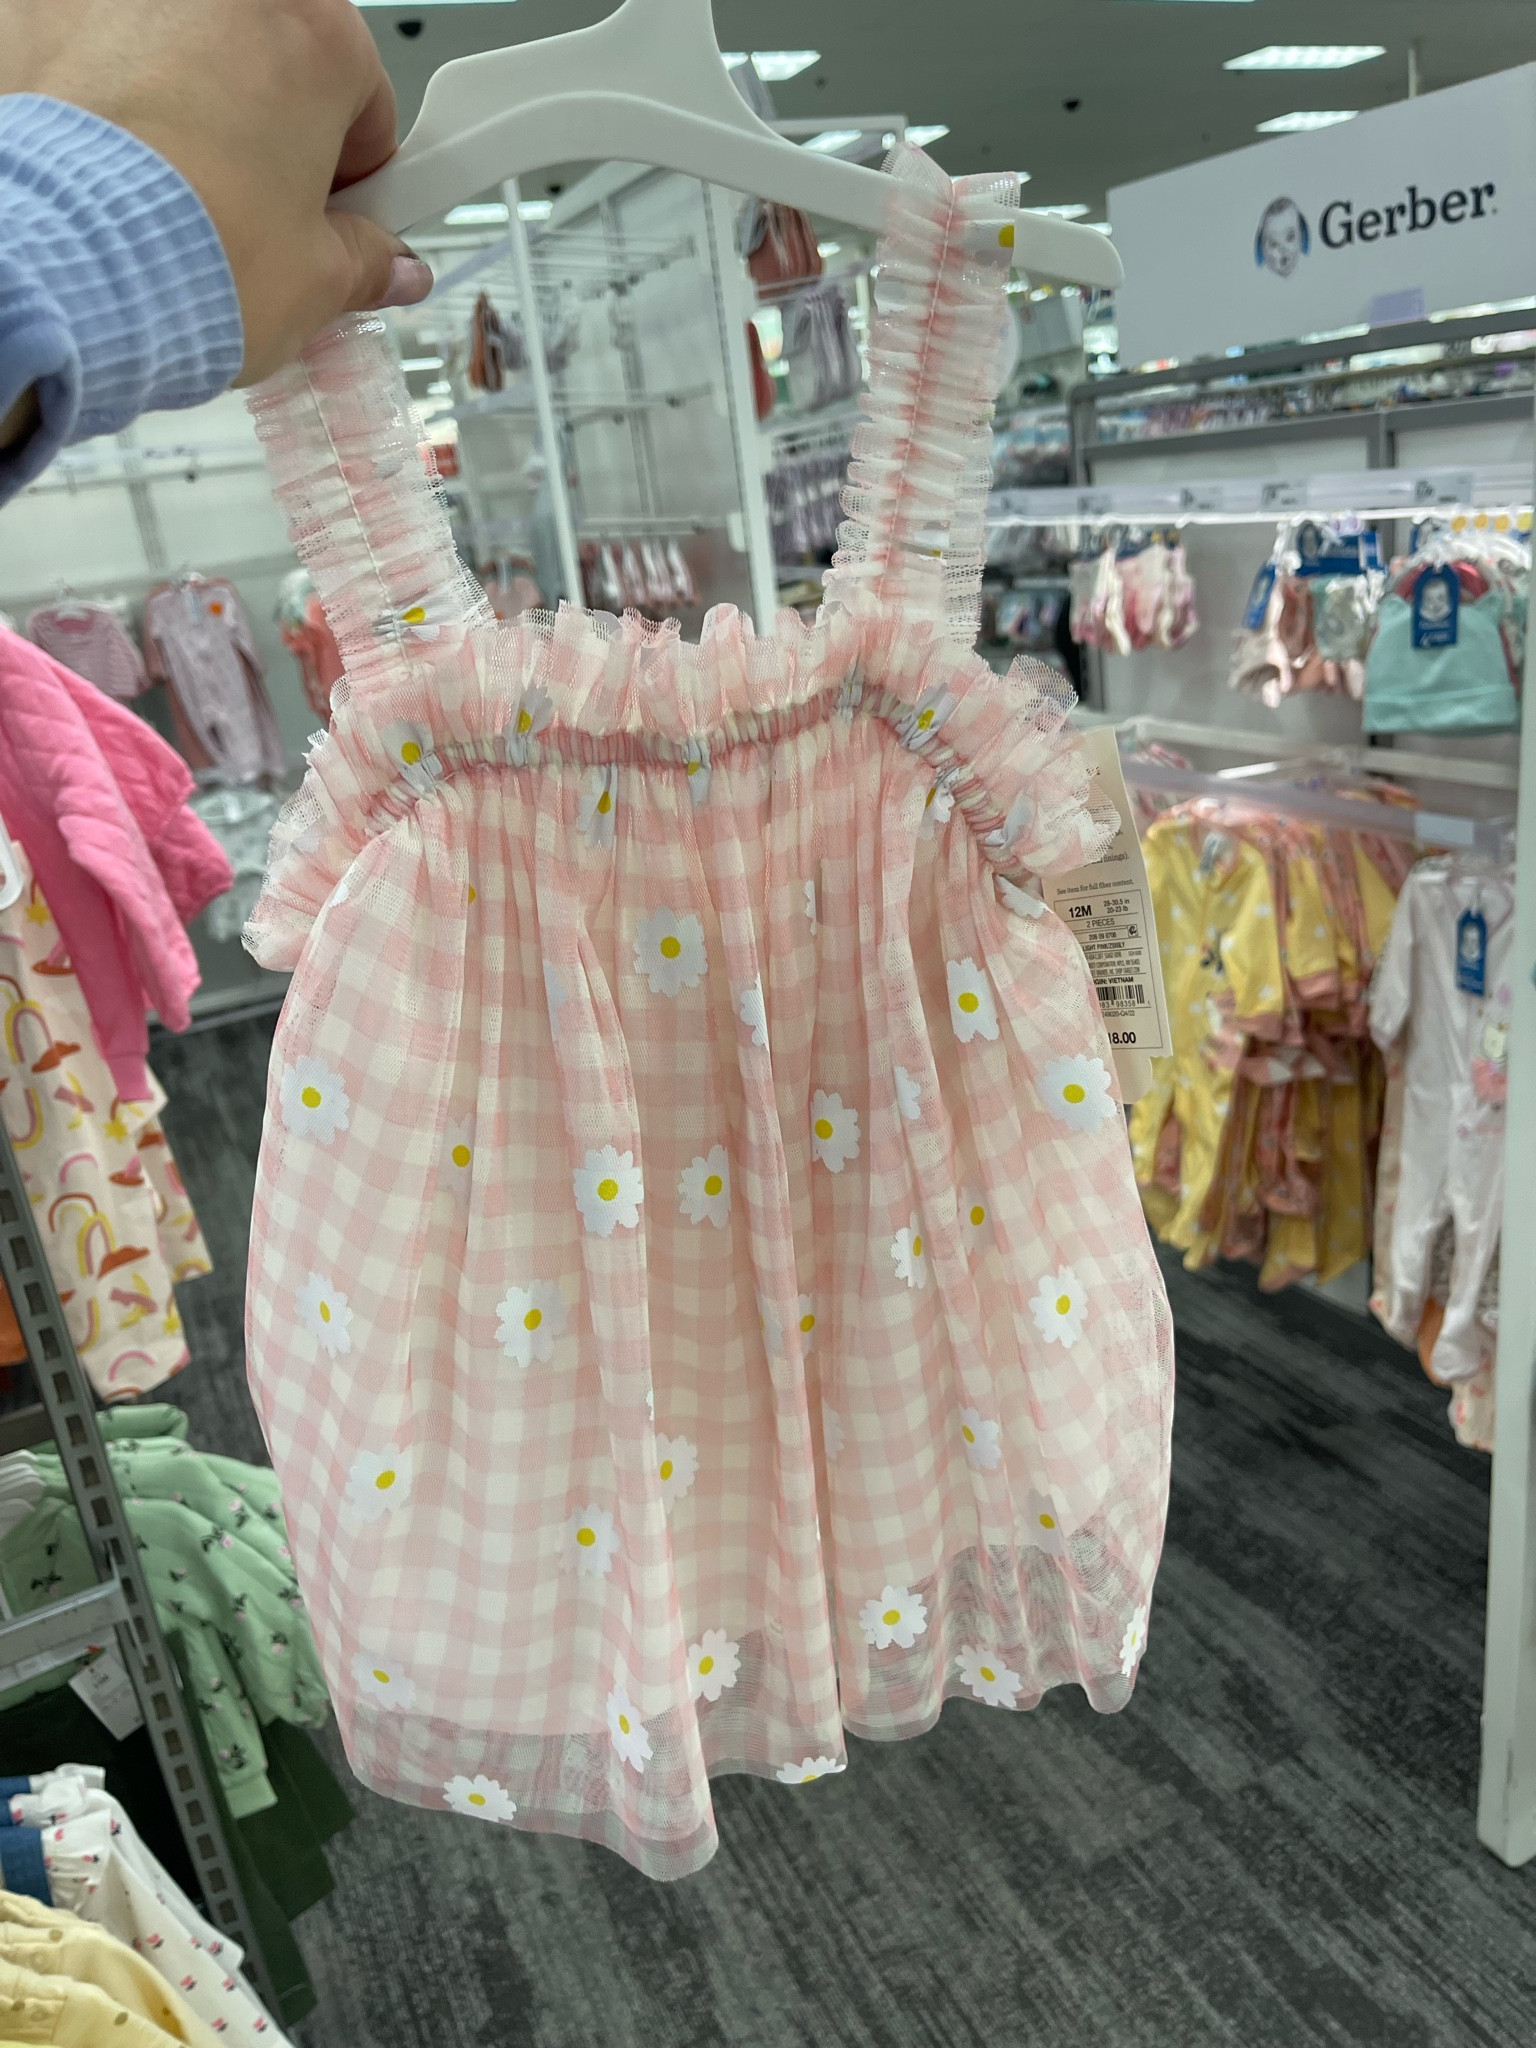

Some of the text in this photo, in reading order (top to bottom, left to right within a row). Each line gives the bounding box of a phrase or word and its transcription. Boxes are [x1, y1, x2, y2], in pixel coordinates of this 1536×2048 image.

[1319, 182, 1495, 249] Gerber
[1067, 886, 1079, 894] item
[1099, 881, 1111, 889] fiber
[1068, 905, 1092, 918] 12M
[1092, 918, 1115, 927] PIECES
[1108, 976, 1134, 984] VIETNAM
